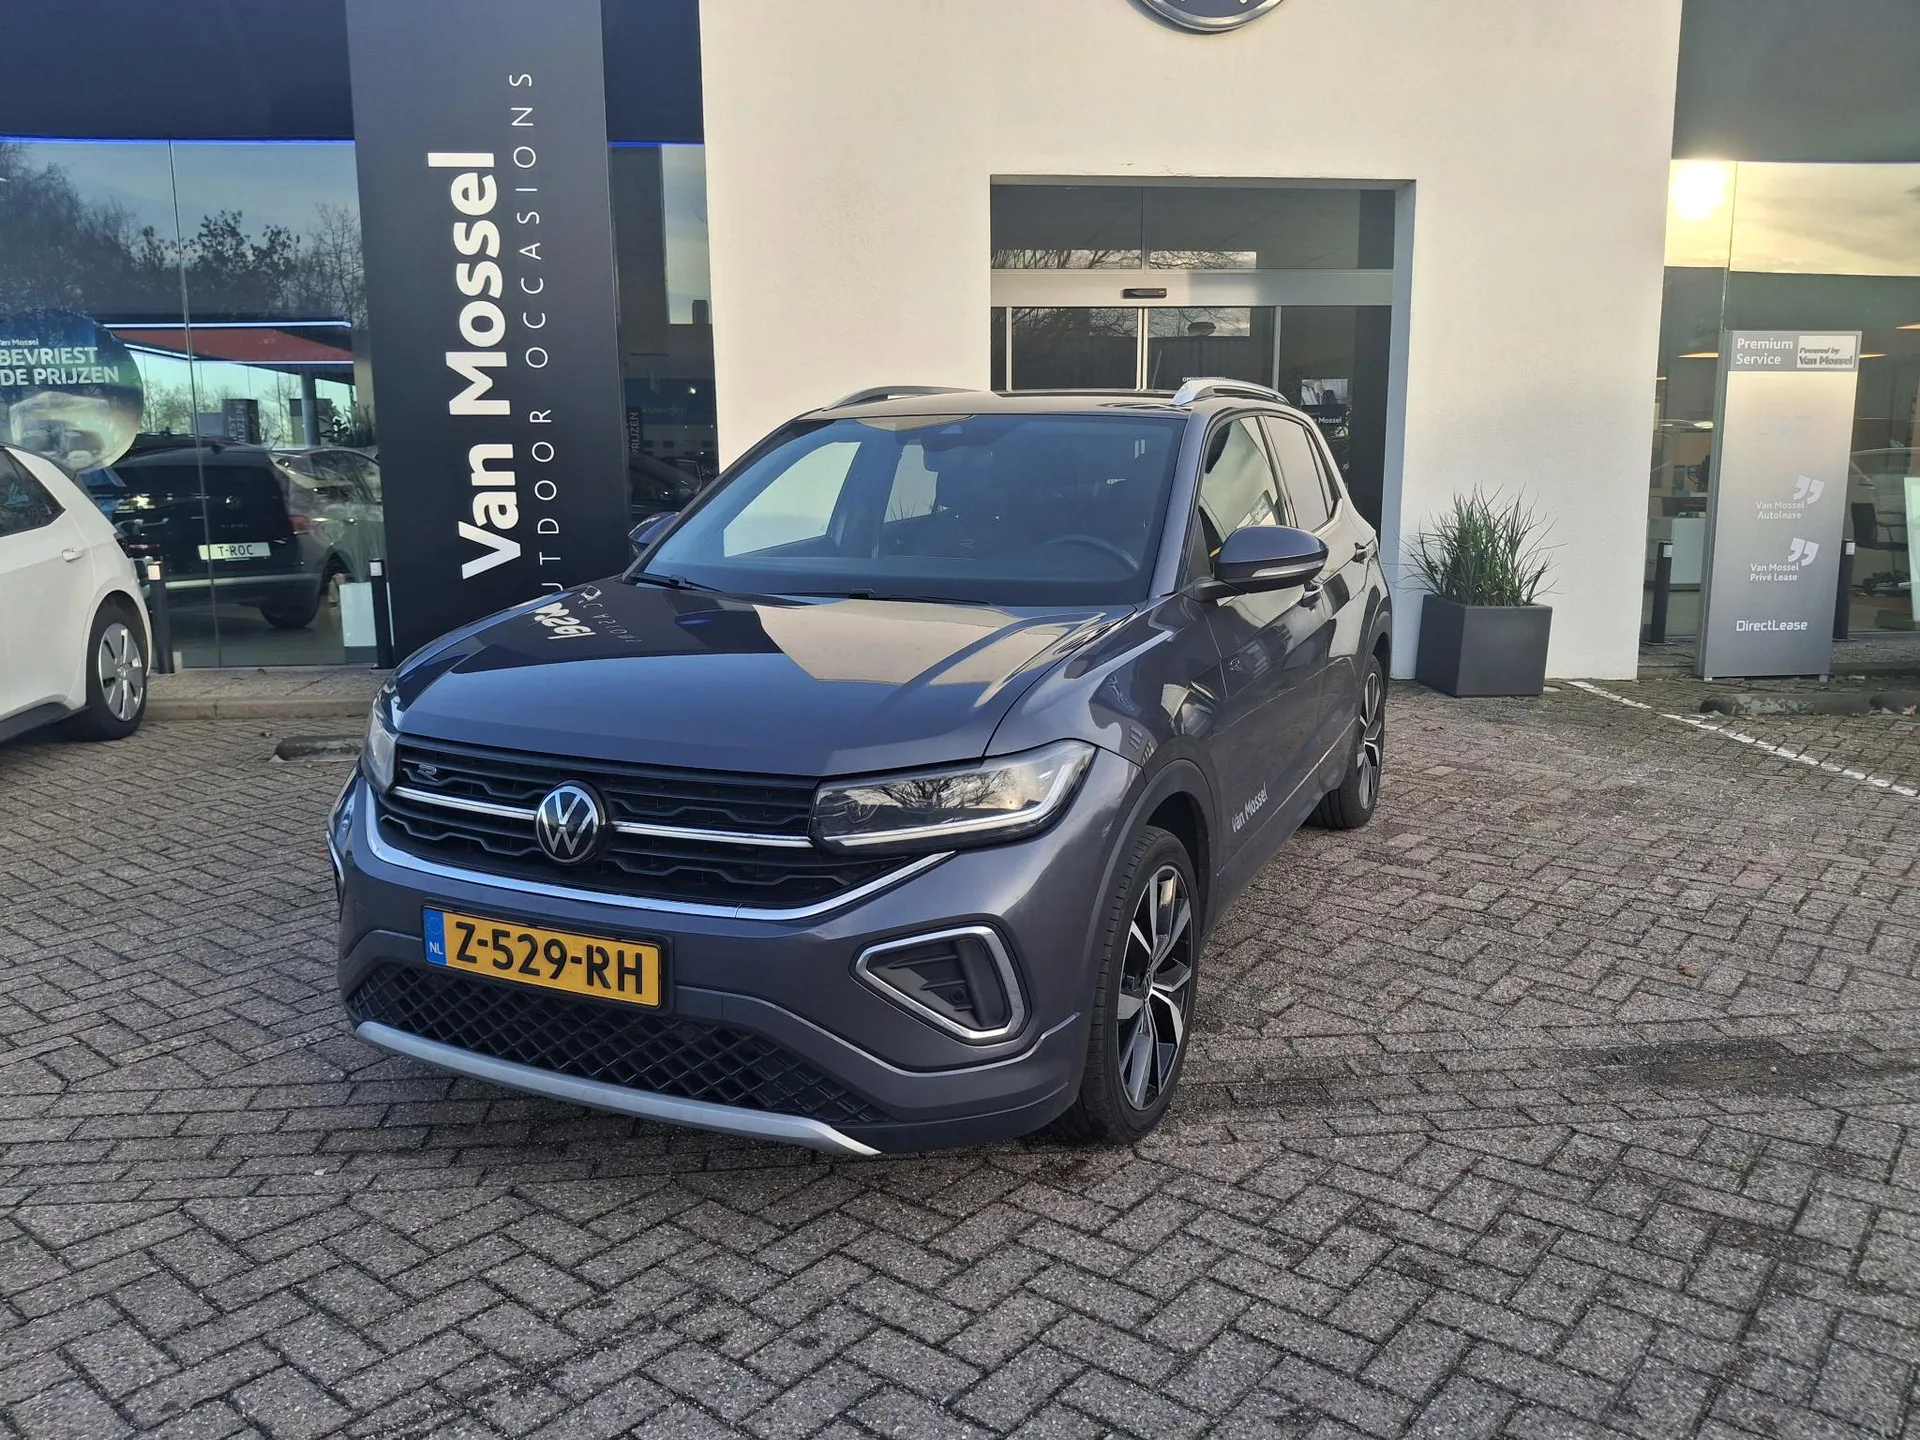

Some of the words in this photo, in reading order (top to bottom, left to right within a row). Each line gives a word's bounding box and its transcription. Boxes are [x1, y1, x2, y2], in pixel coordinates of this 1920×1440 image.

[508, 73, 549, 369] OCCASIONS
[427, 152, 511, 416] Mossel
[0, 338, 12, 346] an
[12, 337, 39, 346] Mossel
[1737, 337, 1794, 349] Premium
[0, 346, 98, 366] BEVRIEST
[1800, 346, 1830, 354] Powered
[1831, 346, 1841, 355] by
[1735, 352, 1782, 365] Service
[1799, 355, 1818, 365] Van
[1819, 354, 1853, 366] Mossel
[0, 368, 30, 386] DE
[33, 365, 120, 385] PRIJZEN
[1318, 416, 1342, 424] Mossel
[457, 443, 522, 580] Van
[1756, 500, 1773, 510] Van
[1774, 500, 1805, 510] Mossel
[1757, 510, 1802, 520] Autolease
[217, 544, 255, 557] T-ROC
[1750, 562, 1767, 572] Van
[1768, 562, 1799, 572] Mossel
[1750, 572, 1772, 582] Privé
[1773, 573, 1798, 582] Lease
[1736, 619, 1808, 632] DirectLease
[1231, 811, 1245, 833] Van
[1244, 780, 1268, 820] Mossel
[429, 941, 444, 956] NL
[455, 921, 643, 995] Z-529-RH
